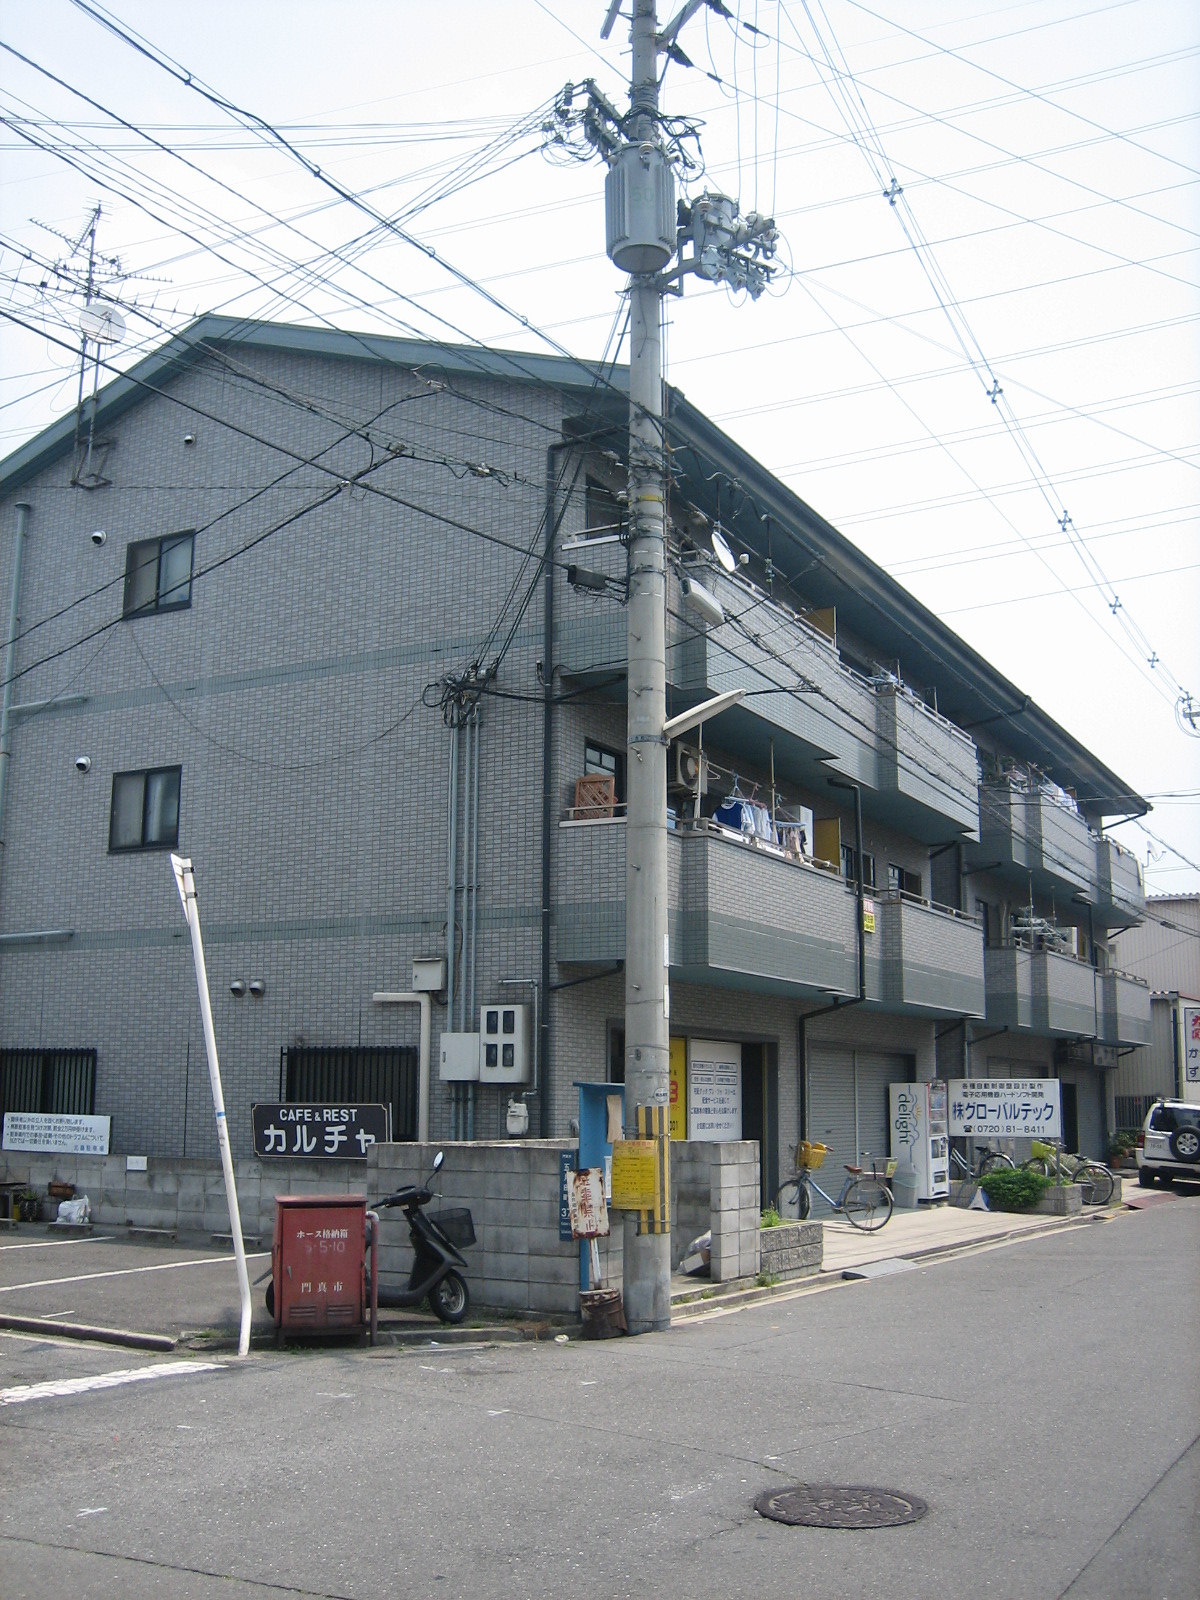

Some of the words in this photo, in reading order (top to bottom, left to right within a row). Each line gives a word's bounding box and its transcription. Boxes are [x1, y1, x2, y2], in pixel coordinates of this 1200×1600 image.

[280, 1109, 312, 1122] CAFE
[314, 1112, 322, 1121] &
[323, 1109, 358, 1122] REST
[895, 1094, 910, 1144] delight
[263, 1124, 376, 1154] カルチャ
[296, 1229, 349, 1239] ホース格納箱
[301, 1281, 344, 1293] 門真市
